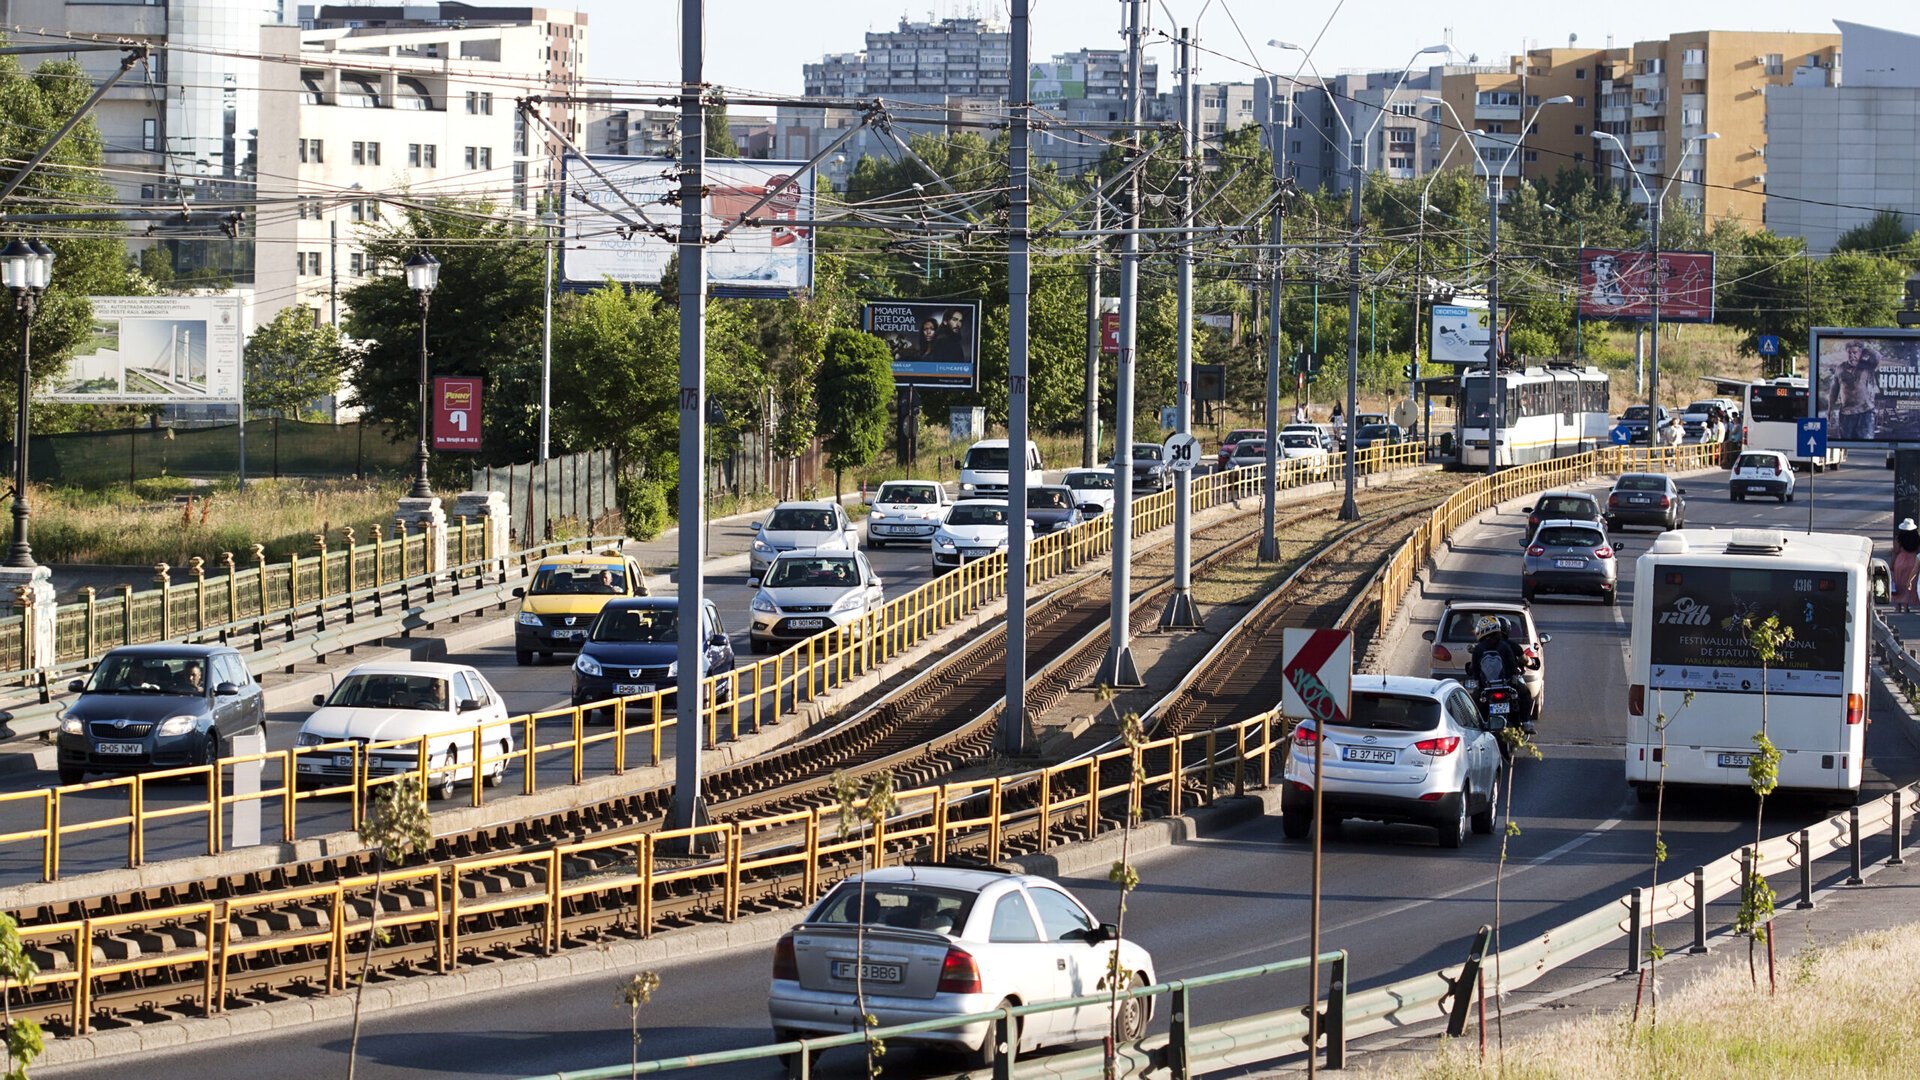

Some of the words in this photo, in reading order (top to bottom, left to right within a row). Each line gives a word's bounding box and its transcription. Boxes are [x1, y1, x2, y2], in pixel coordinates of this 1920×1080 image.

[874, 307, 913, 315] MOARTEA
[1435, 308, 1466, 316] DECATHLON
[874, 315, 892, 323] ESTE
[892, 316, 916, 324] DOAR
[1479, 315, 1488, 328] 4
[1121, 347, 1134, 364] 177
[1010, 376, 1026, 395] 176
[445, 392, 471, 400] PENNY
[1776, 388, 1788, 397] 601
[680, 387, 698, 411] 175
[1171, 444, 1191, 461] 30
[1793, 579, 1813, 592] 4316
[1679, 636, 1734, 647] FESTIVALUL
[1700, 648, 1713, 657] DE
[1716, 648, 1749, 658] STATUI
[100, 744, 106, 753] B
[121, 744, 139, 753] NMV
[1350, 749, 1357, 759] B
[1359, 750, 1371, 760] 37
[1372, 751, 1393, 761] HKP
[1724, 755, 1731, 764] B
[1733, 755, 1744, 765] 55
[870, 966, 897, 980] BBG
